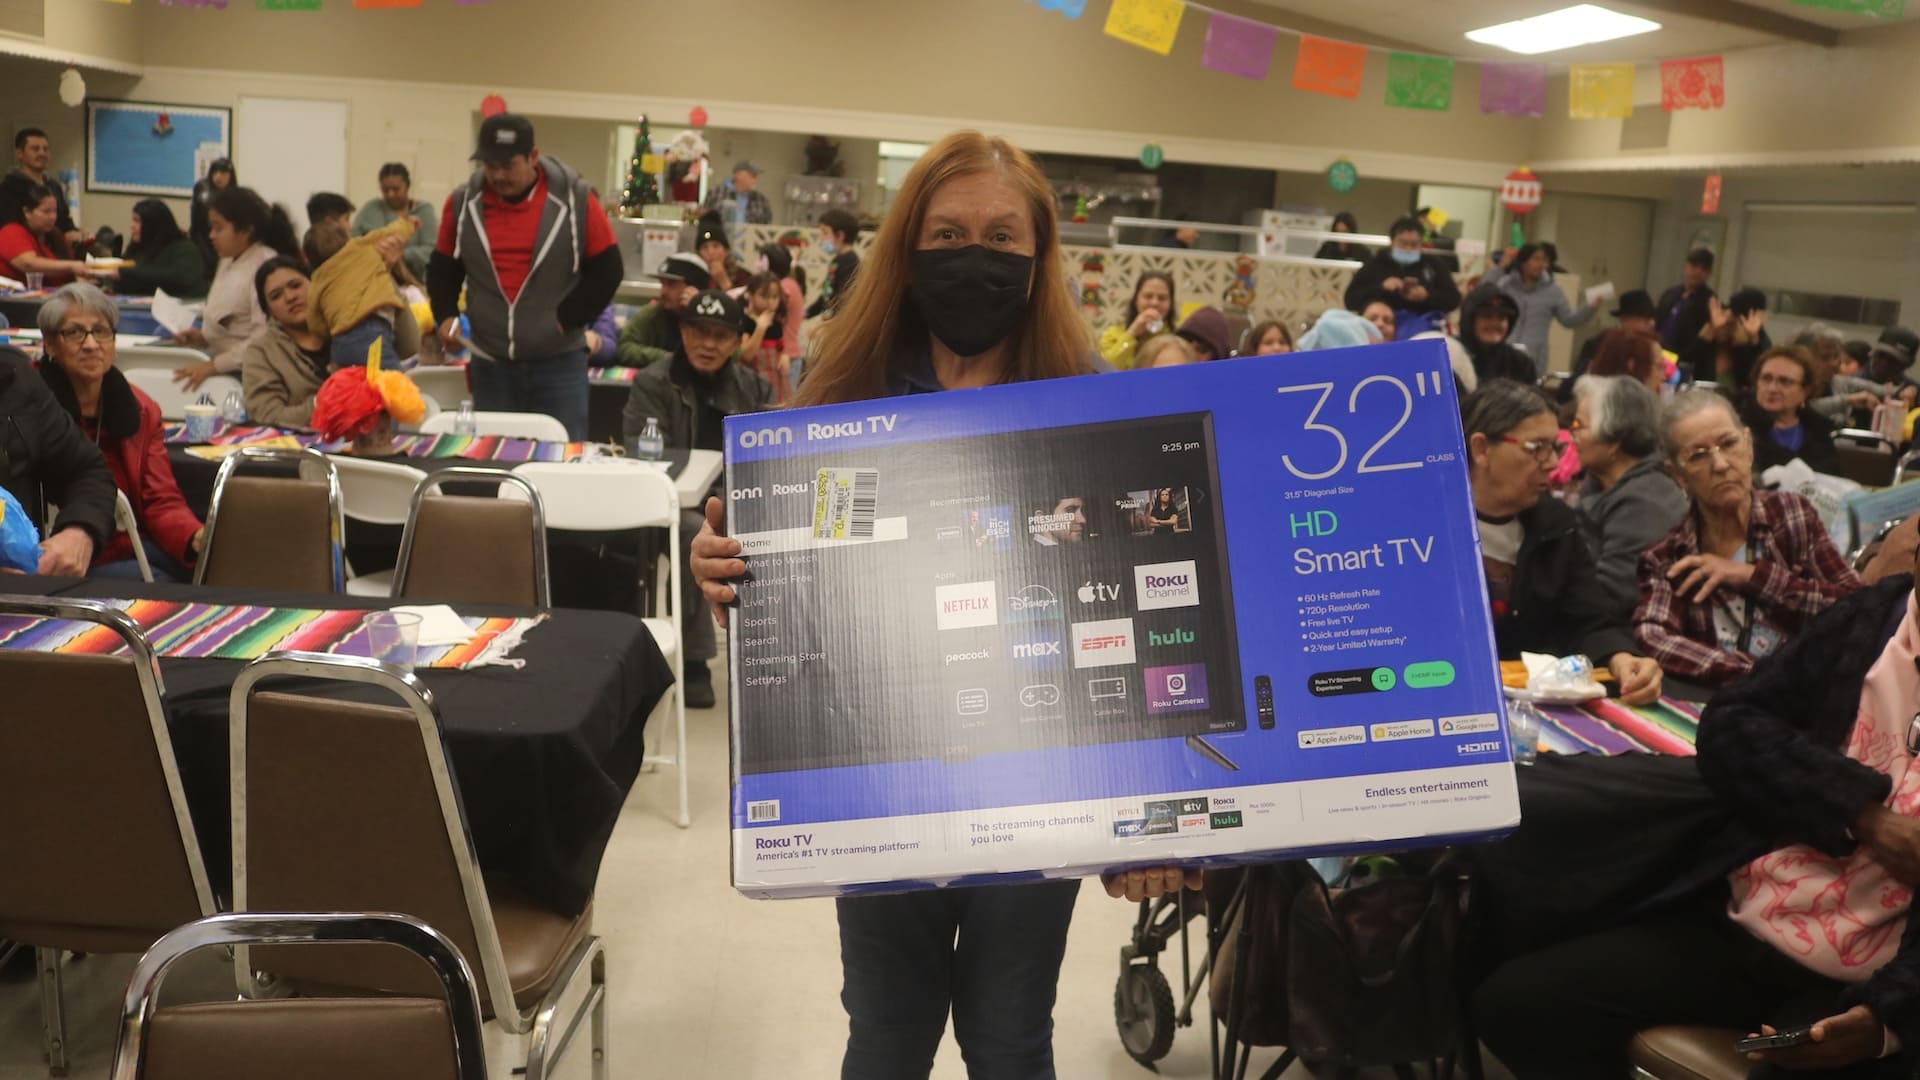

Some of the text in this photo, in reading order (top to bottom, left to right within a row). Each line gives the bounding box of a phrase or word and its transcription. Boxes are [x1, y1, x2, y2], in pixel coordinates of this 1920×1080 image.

[807, 414, 898, 441] Roku TV
[1277, 370, 1442, 480] 32"
[739, 426, 793, 448] onn
[1161, 441, 1200, 453] 9:25 pm
[1426, 453, 1455, 463] CLASS
[730, 486, 763, 501] onn
[772, 482, 809, 497] Roku
[1303, 487, 1337, 498] Diagonal
[1337, 485, 1354, 495] Size
[1028, 512, 1075, 526] PRESUMED
[1289, 510, 1338, 539] HD
[1028, 522, 1071, 534] INNOCENT
[742, 539, 772, 549] Home
[772, 557, 782, 567] to
[1293, 535, 1434, 575] Smart TV
[743, 574, 813, 588] Featured Free
[1145, 574, 1189, 589] Roku
[1098, 582, 1120, 602] tv
[1146, 586, 1190, 598] Channel
[1304, 589, 1381, 603] 60 Hz Refresh Rate
[743, 598, 765, 608] Live
[943, 597, 990, 614] NETFLIX
[1306, 602, 1370, 615] 720p Resolution
[744, 616, 777, 628] Sports
[1307, 616, 1355, 628] Free live TV
[1149, 628, 1195, 646] hulu
[1309, 625, 1393, 641] Quick and easy setup
[744, 635, 779, 647] Search
[1081, 634, 1127, 651] ESPN
[1310, 643, 1335, 653] 2-Year
[1336, 640, 1367, 650] Limited
[1013, 640, 1061, 659] max
[745, 651, 826, 667] Streaming Store
[945, 649, 990, 666] peacock
[745, 674, 787, 687] Settings
[1152, 698, 1205, 709] Roku Cameras
[1388, 727, 1431, 738] Apple Home
[1456, 722, 1478, 731] Google
[1317, 733, 1363, 745] Apple AirPlay
[1457, 741, 1501, 753] HDMI
[1365, 778, 1488, 798] Endless entertainment
[970, 813, 1096, 833] The streaming channels
[1118, 822, 1142, 833] max
[1214, 815, 1238, 826] hulu
[755, 833, 813, 850] Roku TV
[970, 832, 1015, 847] you love
[756, 850, 799, 862] America's
[801, 848, 813, 858] #1
[815, 847, 829, 857] TV
[830, 843, 877, 856] streaming
